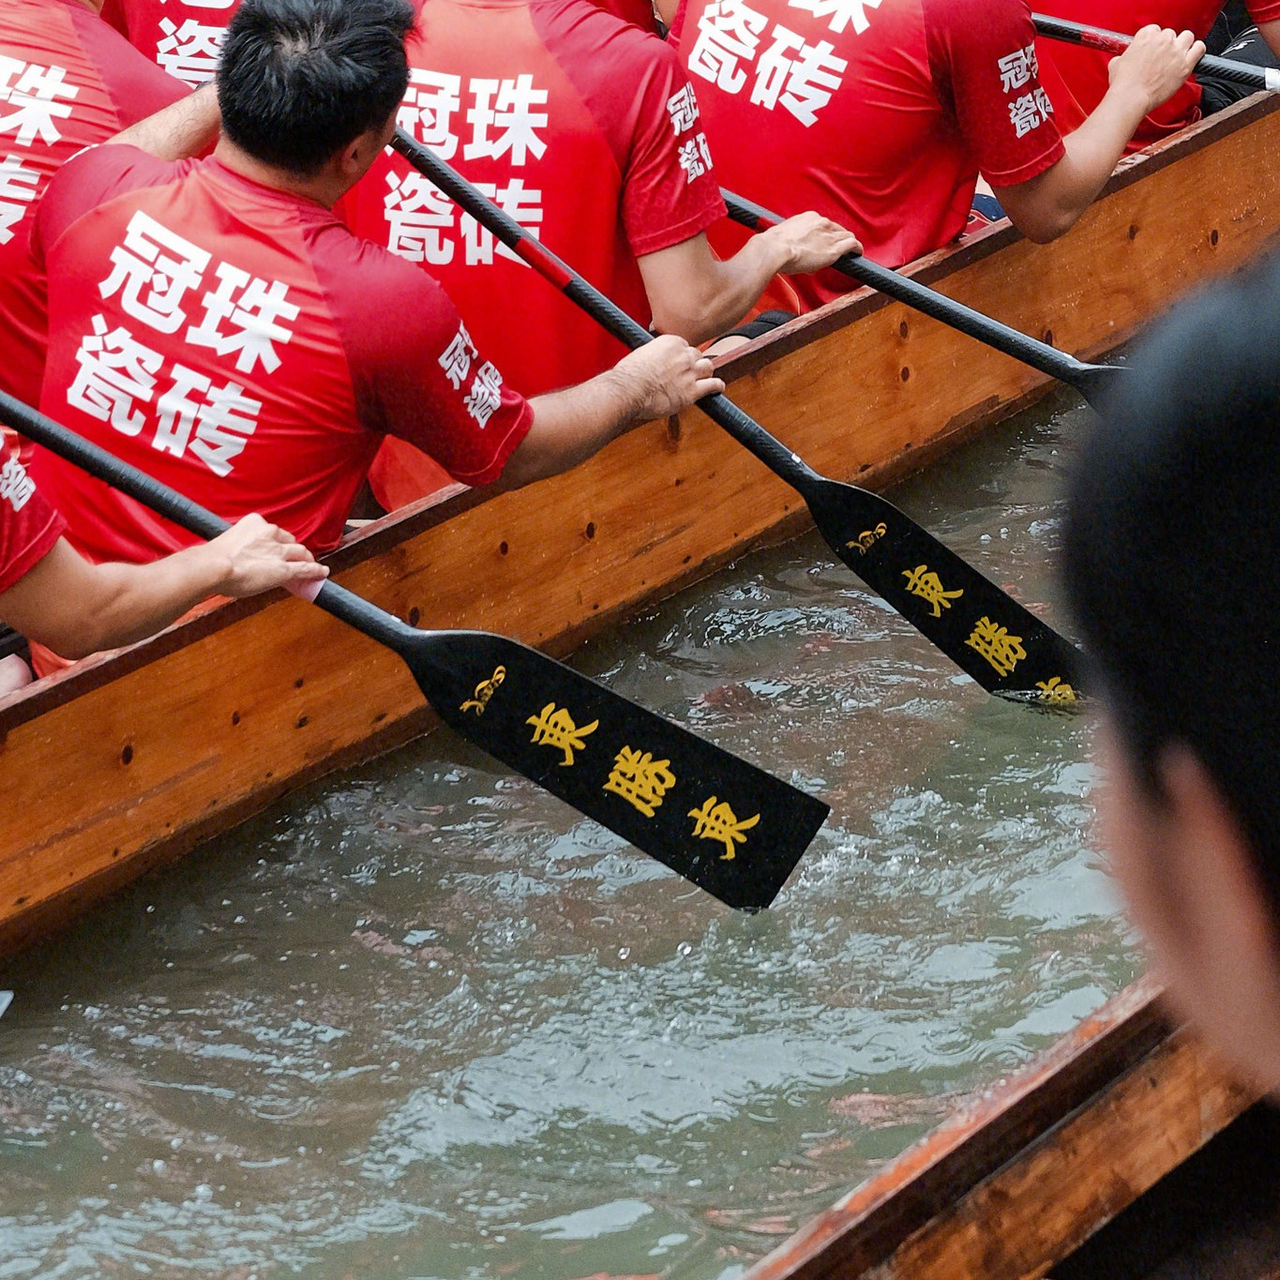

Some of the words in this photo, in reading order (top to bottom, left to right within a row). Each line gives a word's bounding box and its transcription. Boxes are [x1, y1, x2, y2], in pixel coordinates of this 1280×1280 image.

[385, 67, 549, 167] 冠珠
[384, 170, 544, 269] 瓷砖
[97, 210, 301, 378] 冠珠
[65, 313, 263, 481] 瓷砖
